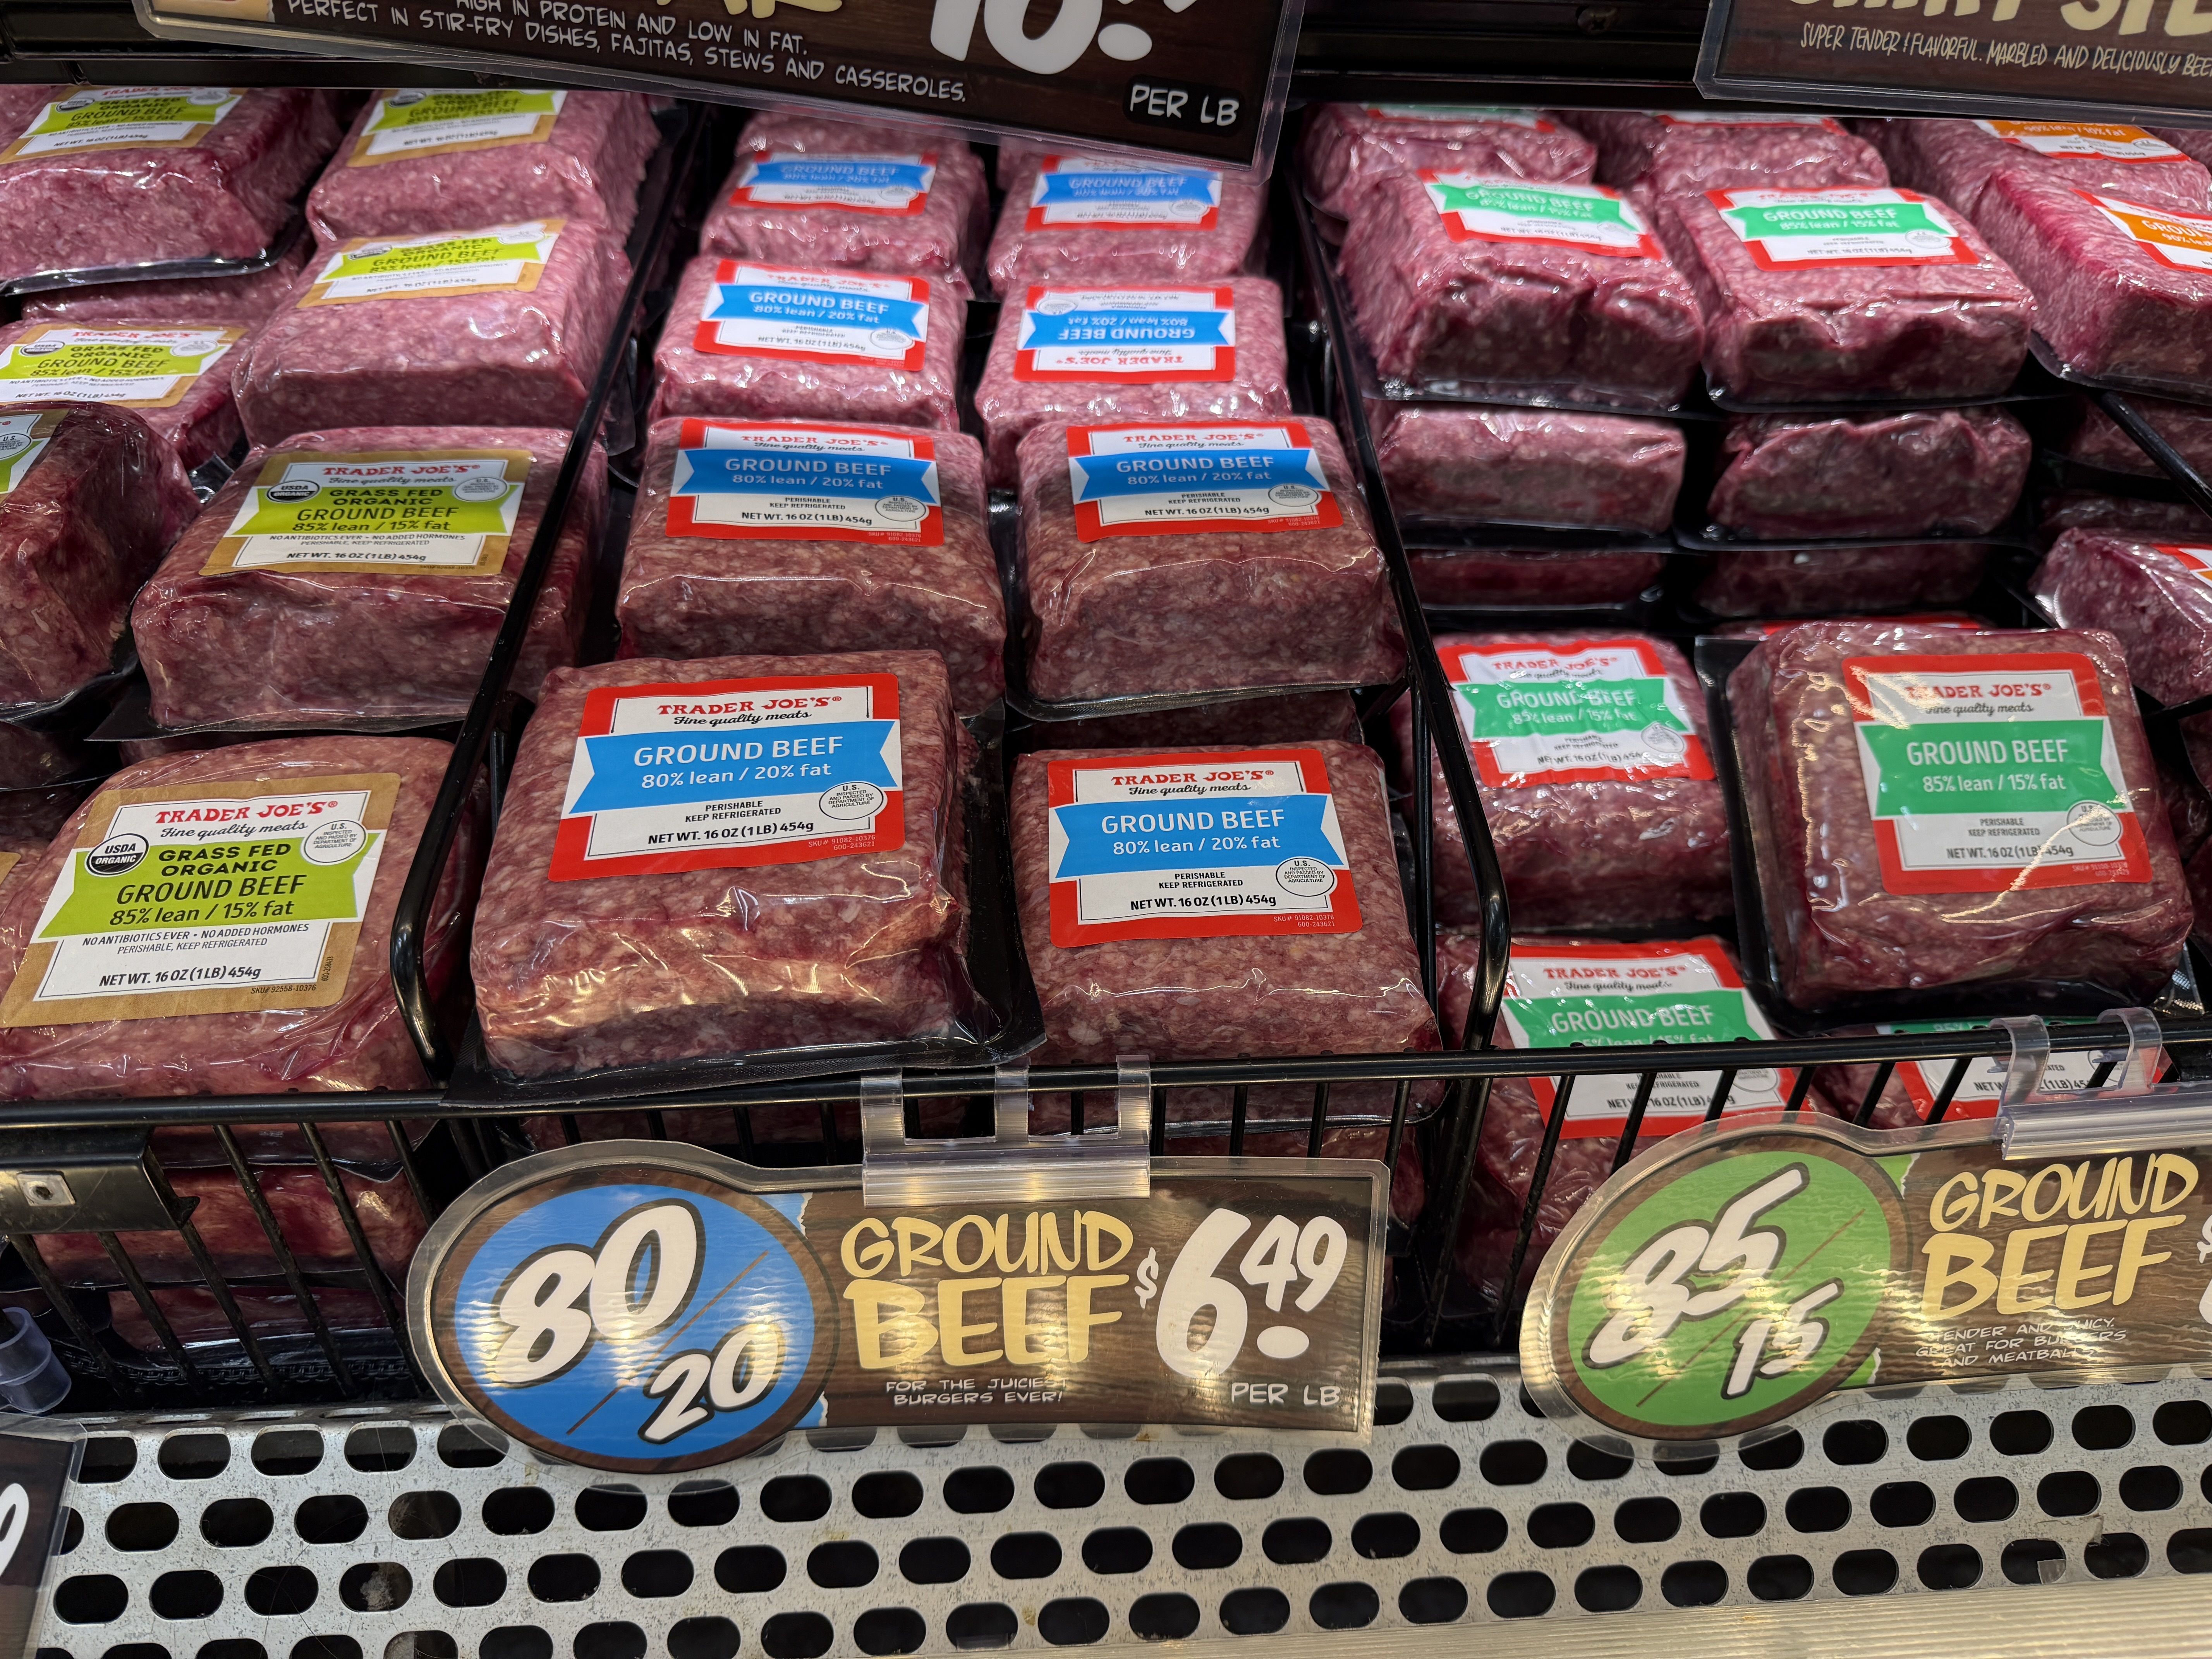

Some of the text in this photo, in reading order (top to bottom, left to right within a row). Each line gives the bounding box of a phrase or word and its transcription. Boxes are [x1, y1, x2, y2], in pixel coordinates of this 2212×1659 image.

[457, 0, 501, 12] HIGH
[513, 0, 529, 17] IN
[542, 2, 625, 31] PROTEIN
[637, 13, 676, 36] AND
[689, 20, 732, 43] LOW
[744, 29, 759, 49] IN
[773, 33, 807, 56] FAT.
[289, 0, 966, 103] PERFECT IN STIR-FRY DISHES, FAJITAS, STEWS AND CASSEROLES.
[1801, 21, 1844, 50] SUPER
[1850, 26, 1900, 56] TENDER
[1910, 33, 1982, 61] FLAVORFUL.
[1987, 40, 2047, 67] MARBLED
[2054, 45, 2090, 69] AND
[2092, 46, 2181, 74] DELICIOUSLY
[2182, 53, 2212, 77] BEE
[1130, 84, 1239, 127] PER LB
[1465, 189, 1594, 213] GROUND BEEF
[1762, 208, 1898, 222] GROUND BEEF
[749, 292, 889, 314] GROUND BEEF
[1058, 328, 1195, 340] GROUND BEEF
[38, 358, 170, 369] GROUND BEEF
[725, 458, 891, 476] GROUND BEEF
[1116, 456, 1274, 473] GROUND BEEF
[297, 507, 459, 520] GROUND BEEF
[657, 701, 755, 714] TRADER
[674, 710, 812, 727] Fine quality meats
[634, 736, 843, 767] GROUND BEEF
[1906, 739, 2068, 766] GROUND BEEF
[641, 763, 831, 789] 80% lean / 20% fat
[1111, 773, 1197, 786] TRADER
[1922, 773, 2066, 792] 85% lean / 15% fat
[156, 807, 250, 823] TRADER
[685, 808, 781, 823] KEEP REFRIGERATED
[706, 800, 763, 812] PERISHABLE
[161, 821, 308, 840] Fine quality meats
[1102, 809, 1285, 834] GROUND BEEF
[648, 822, 814, 844] NET WT. 16 OZ (1 LB) 454g
[831, 835, 876, 844] 91082-10376
[105, 843, 136, 854] USDA
[159, 844, 291, 861] GRASS FED
[834, 841, 874, 850] 600-243621
[1113, 836, 1281, 855] 80% lean / 20% fat
[95, 855, 136, 864] ORGANIC
[162, 860, 278, 876] ORGANIC
[117, 874, 307, 905] GROUND BEEF
[110, 900, 294, 926] 85% lean / 15% fat
[82, 937, 97, 946] NO
[98, 932, 161, 945] ANTIBIOTICS
[201, 930, 216, 938] NO
[217, 928, 251, 938] ADDED
[252, 923, 310, 935] HORMONES
[117, 938, 267, 954] PERISHABLE, KEEP REFRIGERATED
[100, 966, 261, 986] NET WT. 16 OZ (1 LB) 454g
[271, 984, 316, 993] 92558-10376
[1929, 1153, 2199, 1232] GROUND
[840, 1209, 1134, 1278] GROUND
[1589, 1169, 1804, 1363] 85
[1921, 1215, 2186, 1319] BEEF
[489, 1204, 698, 1383] 80
[842, 1274, 1130, 1369] BEEF
[2016, 1323, 2052, 1335] AND
[1726, 1282, 1839, 1395] 15
[1986, 1338, 2024, 1350] FOR
[1941, 1355, 1978, 1367] AND
[644, 1324, 782, 1443] 20
[886, 1380, 927, 1393] FOR
[939, 1379, 975, 1391] THE
[894, 1391, 1063, 1405] BURGERS EVER!
[1230, 1382, 1341, 1407] PER LB
